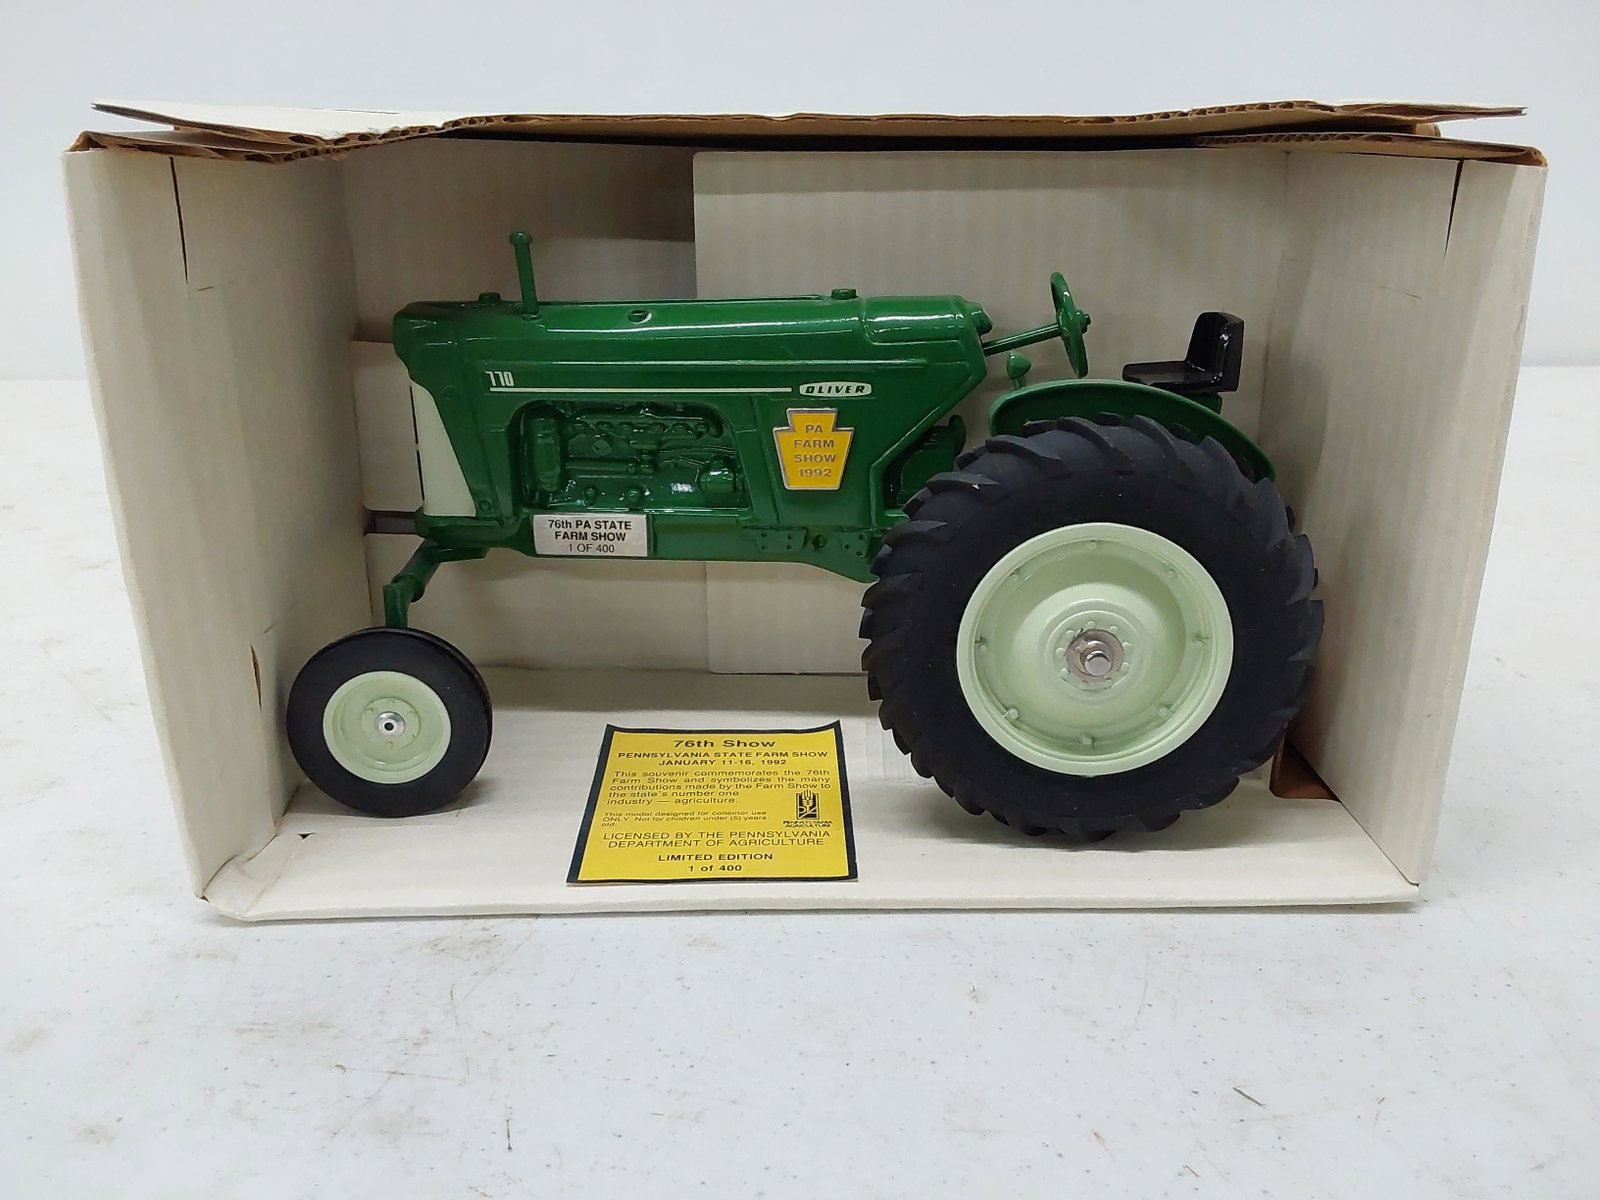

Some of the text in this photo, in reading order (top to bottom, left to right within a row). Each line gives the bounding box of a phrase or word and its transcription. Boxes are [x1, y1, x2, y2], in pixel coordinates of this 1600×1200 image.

[484, 371, 515, 387] 770
[805, 385, 866, 394] OLIVER
[805, 424, 823, 433] PA
[793, 439, 834, 448] FARM
[794, 454, 837, 463] SHOW
[799, 468, 832, 477] 1992
[548, 519, 632, 530] 76th PA STATE
[555, 531, 626, 541] FARM SHOW
[568, 543, 615, 553] 1 OF 400
[722, 739, 776, 747] Show
[603, 832, 670, 840] LICENSED
[608, 840, 701, 848] DEPARTMENT
[729, 838, 824, 846] AGRICULTURE
[658, 854, 713, 862] LIMITED
